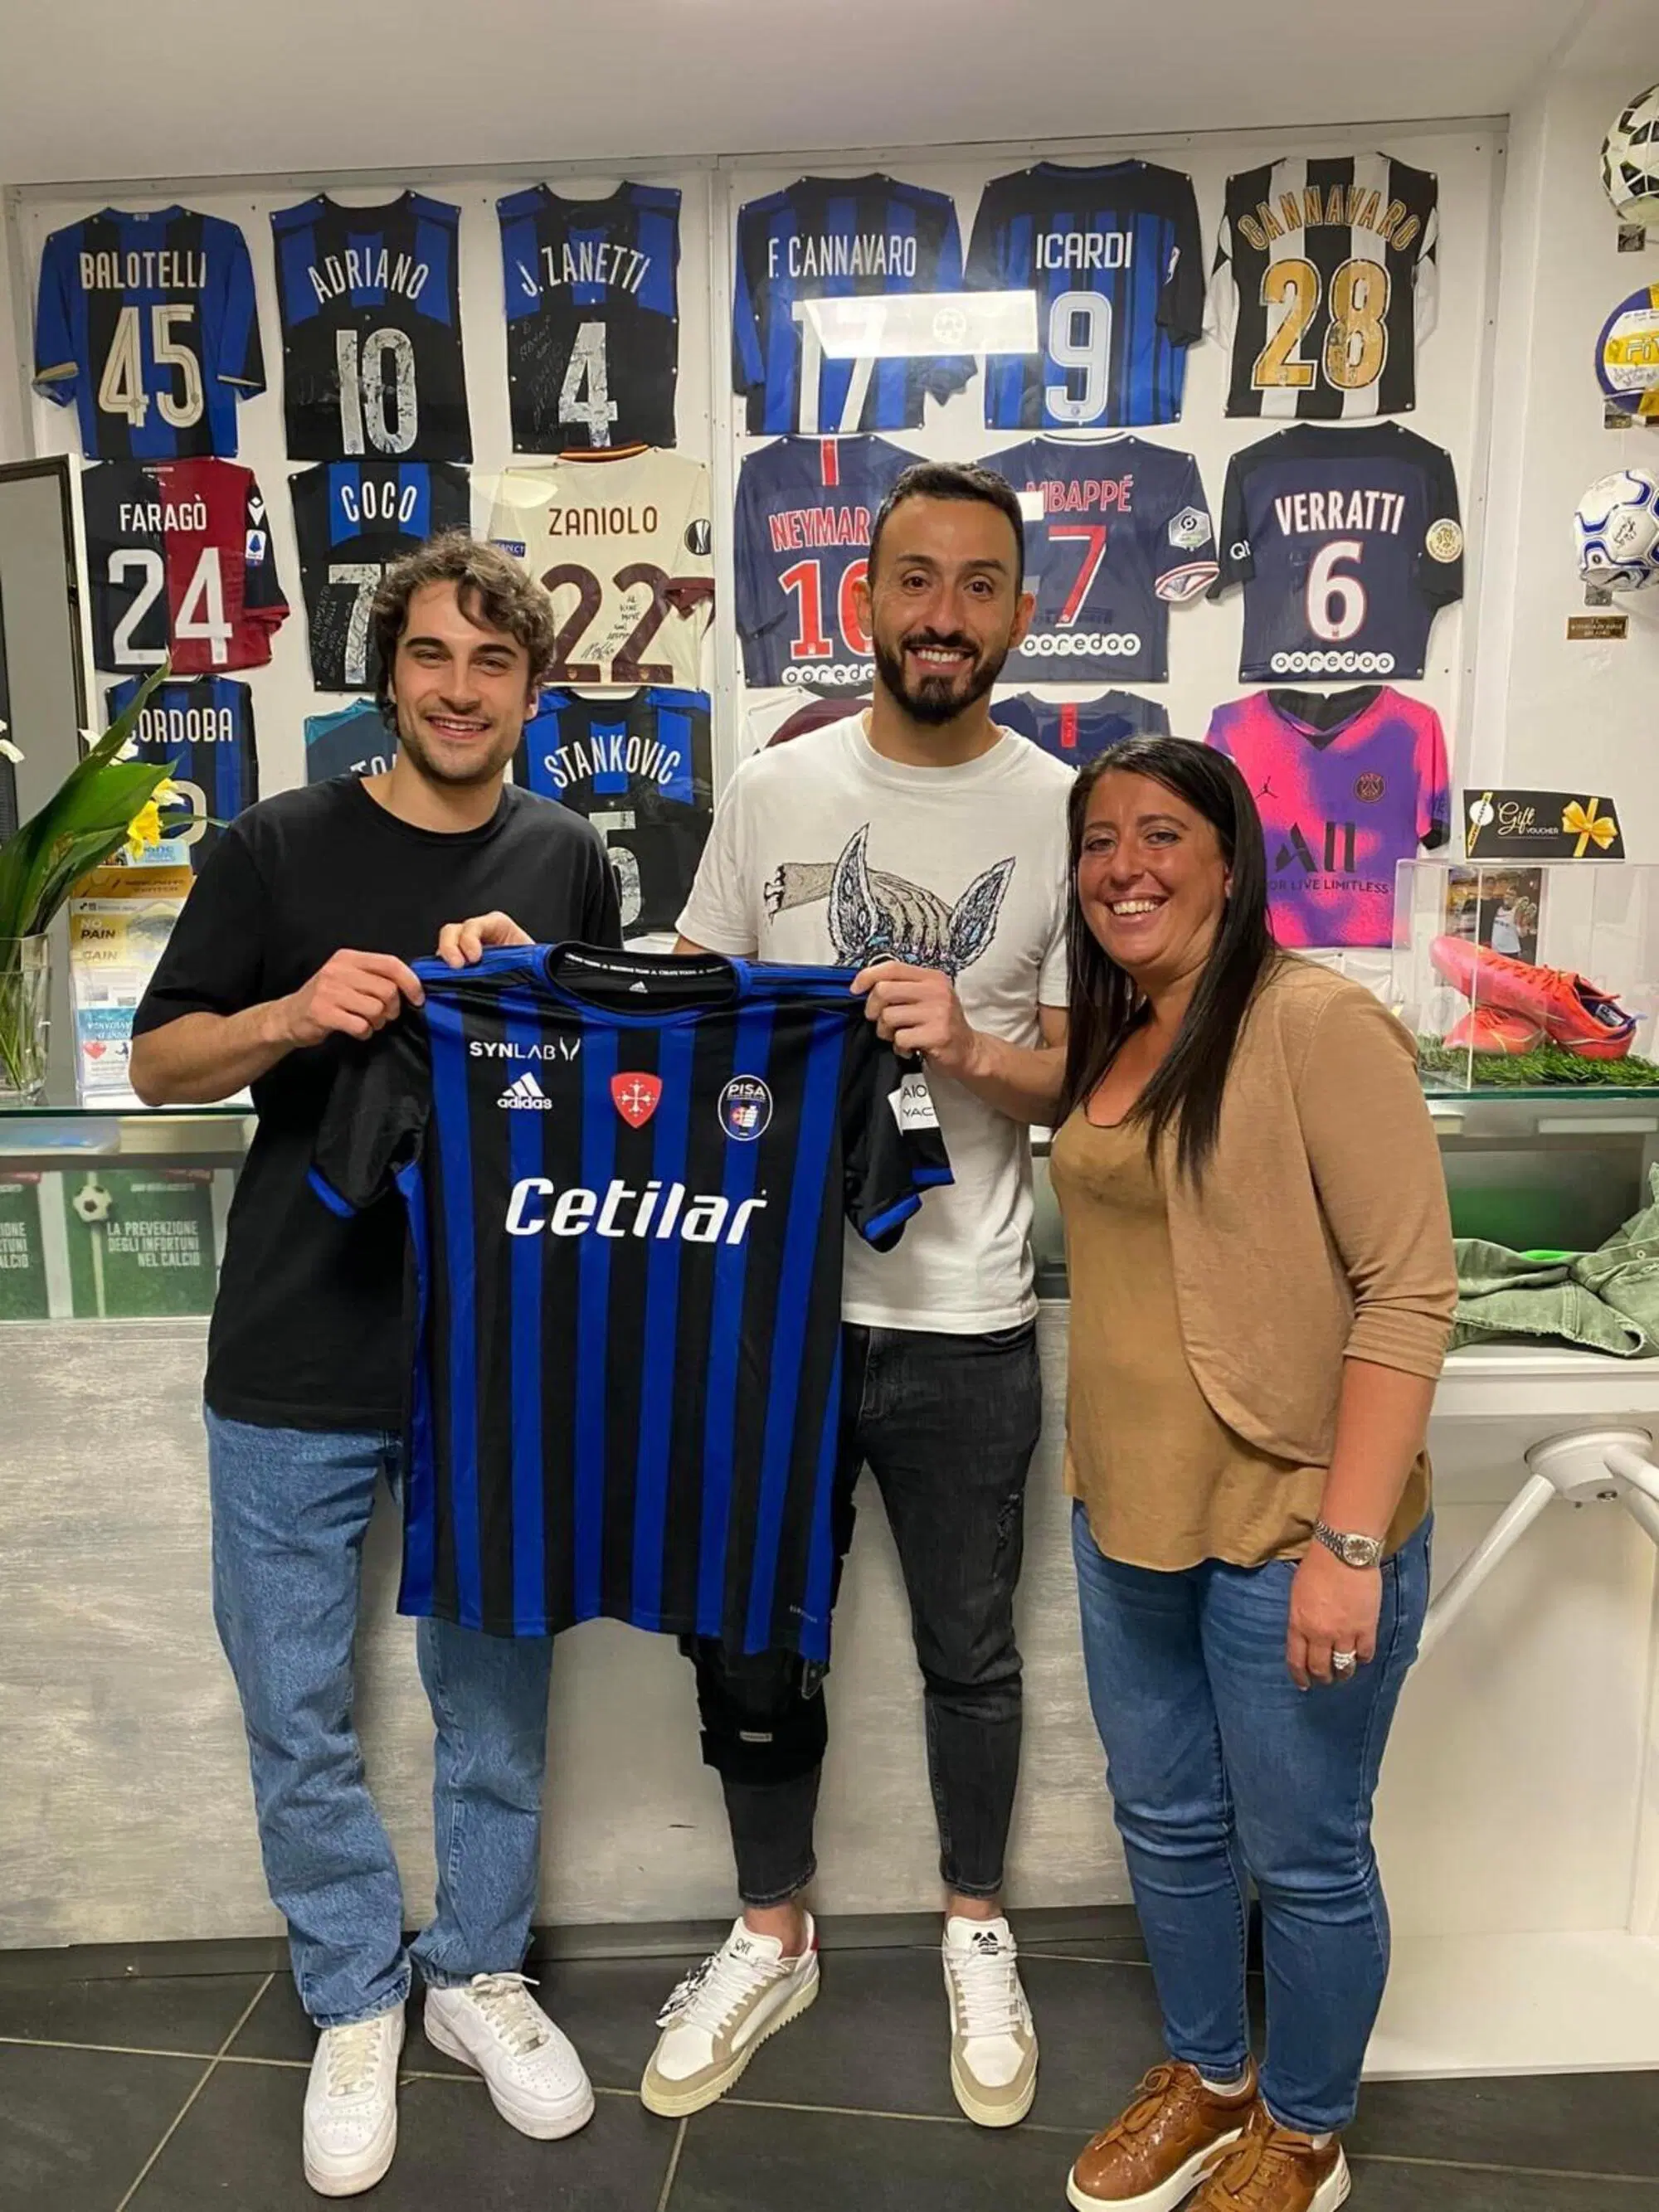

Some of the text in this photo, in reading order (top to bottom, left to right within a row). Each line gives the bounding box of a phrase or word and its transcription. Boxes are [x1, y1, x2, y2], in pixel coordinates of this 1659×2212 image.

[1238, 184, 1420, 250] CANNAVARO
[80, 251, 207, 289] BALOTELLI
[541, 241, 652, 294] ZANETTI
[789, 234, 917, 278] CANNAVARO
[1036, 231, 1131, 270] ICARDI
[308, 247, 430, 304] ADRIANO
[1251, 258, 1391, 391] 28
[98, 304, 204, 429] 45
[791, 299, 888, 434] 17
[1044, 290, 1112, 422] 9
[335, 328, 416, 455] 10
[558, 322, 617, 447] 4
[119, 493, 207, 532] FARAGÒ
[341, 481, 417, 522] COCO
[548, 506, 658, 537] ZANIOLO
[1275, 489, 1405, 536] VERRATTI
[768, 507, 871, 552] NEYMAR
[1048, 524, 1107, 629] 7
[1306, 539, 1368, 643] 6
[108, 547, 233, 664] 24
[539, 562, 674, 683] 22
[1021, 634, 1139, 654] ooredoo
[1272, 650, 1394, 673] ooredoo
[131, 707, 233, 743] ORDOBA
[544, 734, 682, 788] STANKOVIC
[1497, 801, 1535, 836] Gift
[1291, 879, 1321, 890] LIVE
[1324, 880, 1389, 894] LIMITLESS
[80, 929, 116, 940] PAIN
[469, 1039, 556, 1061] SYNLAB
[497, 1094, 552, 1111] adidas
[728, 1083, 765, 1097] PISA
[107, 1220, 199, 1236] LA PREVENZIONE
[504, 1176, 768, 1246] Cetilar
[138, 1251, 201, 1267] NEL CALCIO
